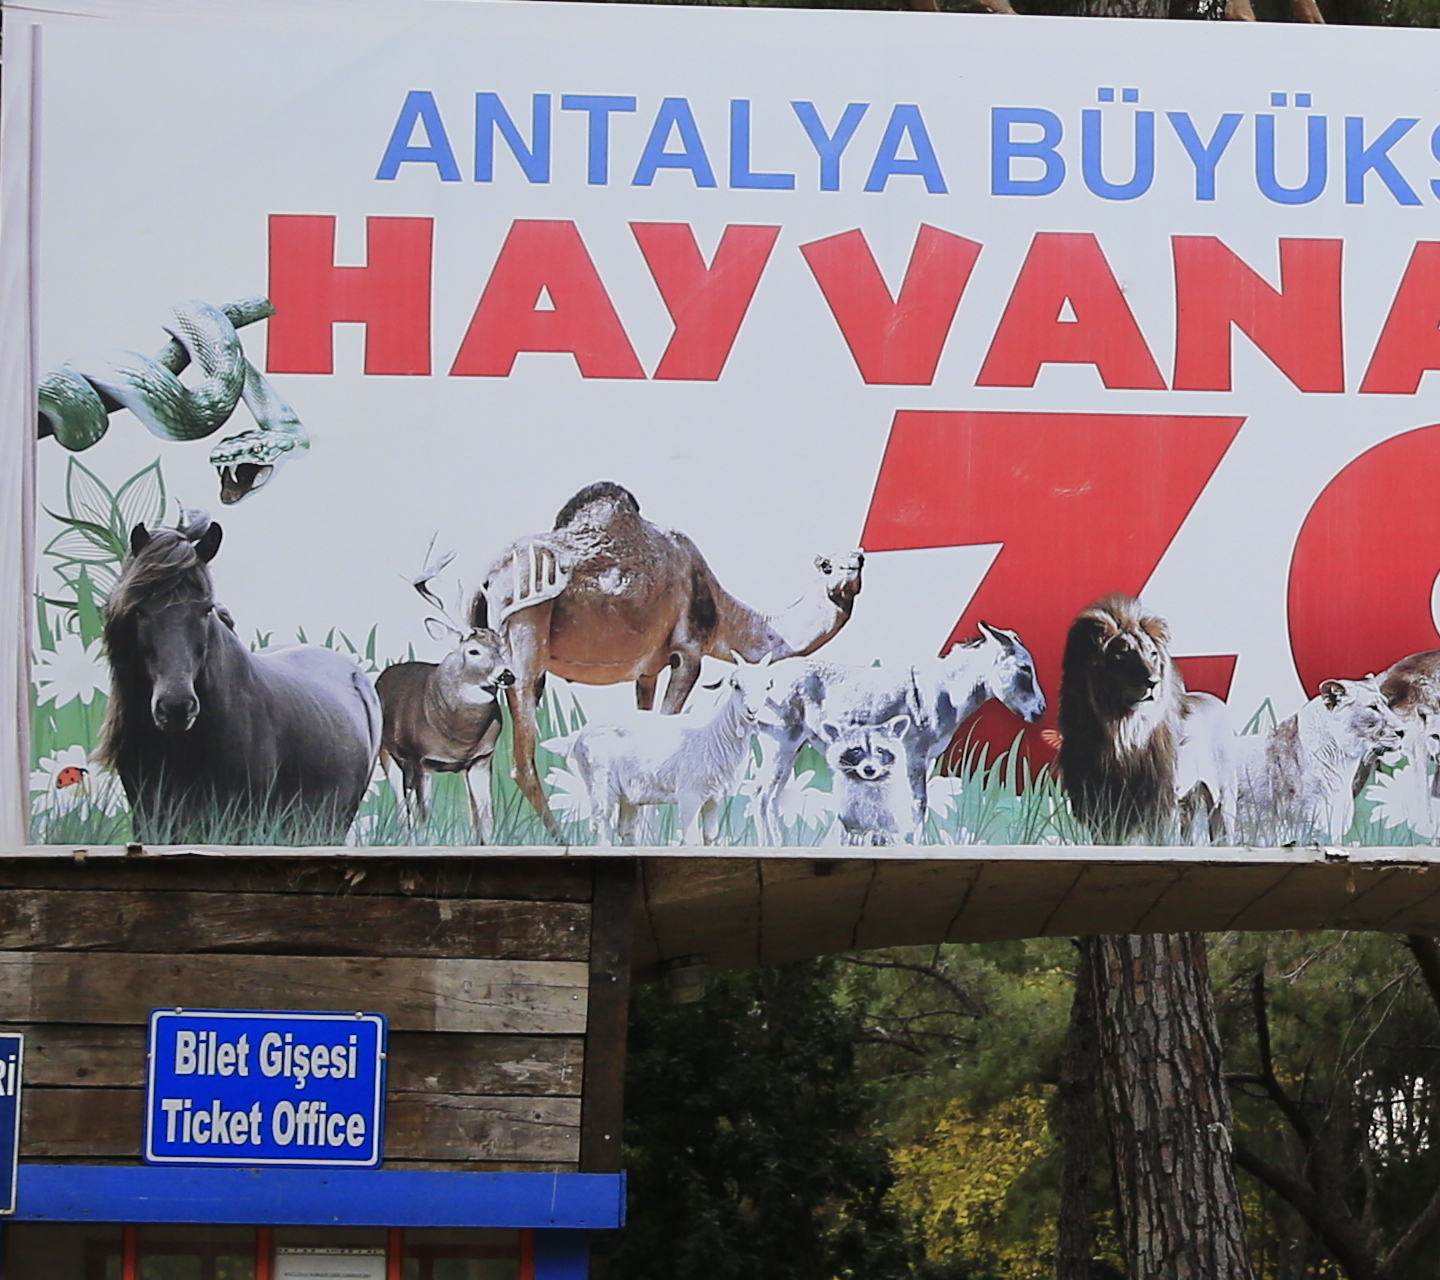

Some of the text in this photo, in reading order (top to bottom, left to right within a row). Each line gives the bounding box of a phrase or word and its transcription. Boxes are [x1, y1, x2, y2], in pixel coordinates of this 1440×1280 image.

[375, 89, 950, 196] ANTALYA
[174, 1030, 358, 1090] Bilet Gişesi
[161, 1099, 366, 1147] Ticket Office
